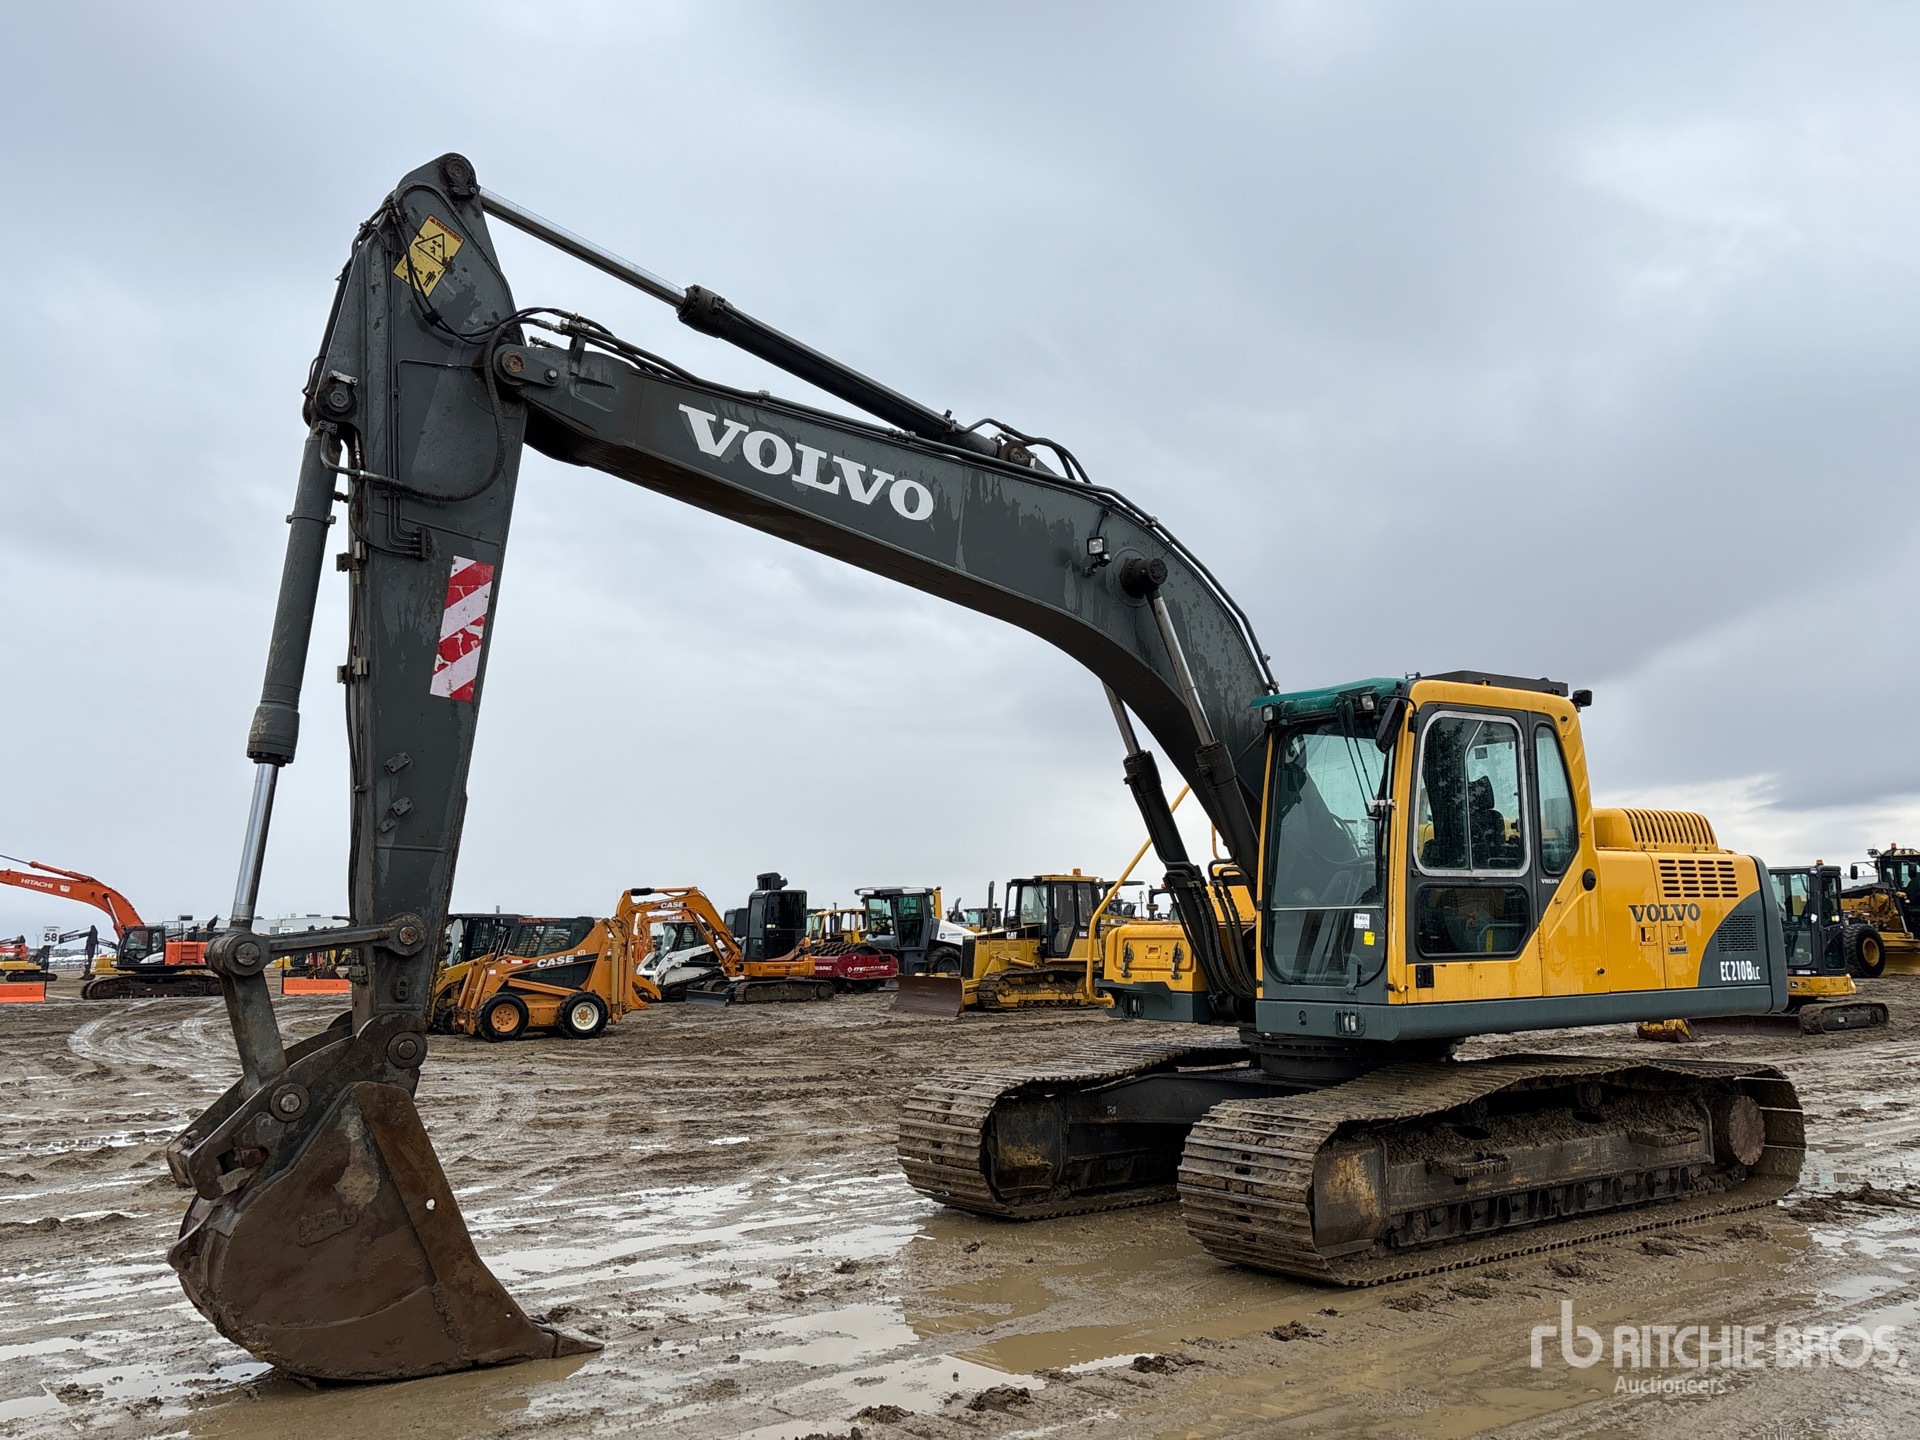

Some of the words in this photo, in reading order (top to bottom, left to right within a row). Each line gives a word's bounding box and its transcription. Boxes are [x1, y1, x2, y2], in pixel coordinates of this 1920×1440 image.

[436, 222, 462, 243] WARNING
[678, 403, 934, 521] VOLVO
[20, 878, 54, 889] HITACHI
[660, 901, 684, 909] CASE
[1628, 903, 1701, 922] VOLVO
[43, 933, 58, 942] 58
[1006, 931, 1018, 940] CAT
[536, 954, 576, 968] CASE
[853, 964, 889, 972] DYNAPAC
